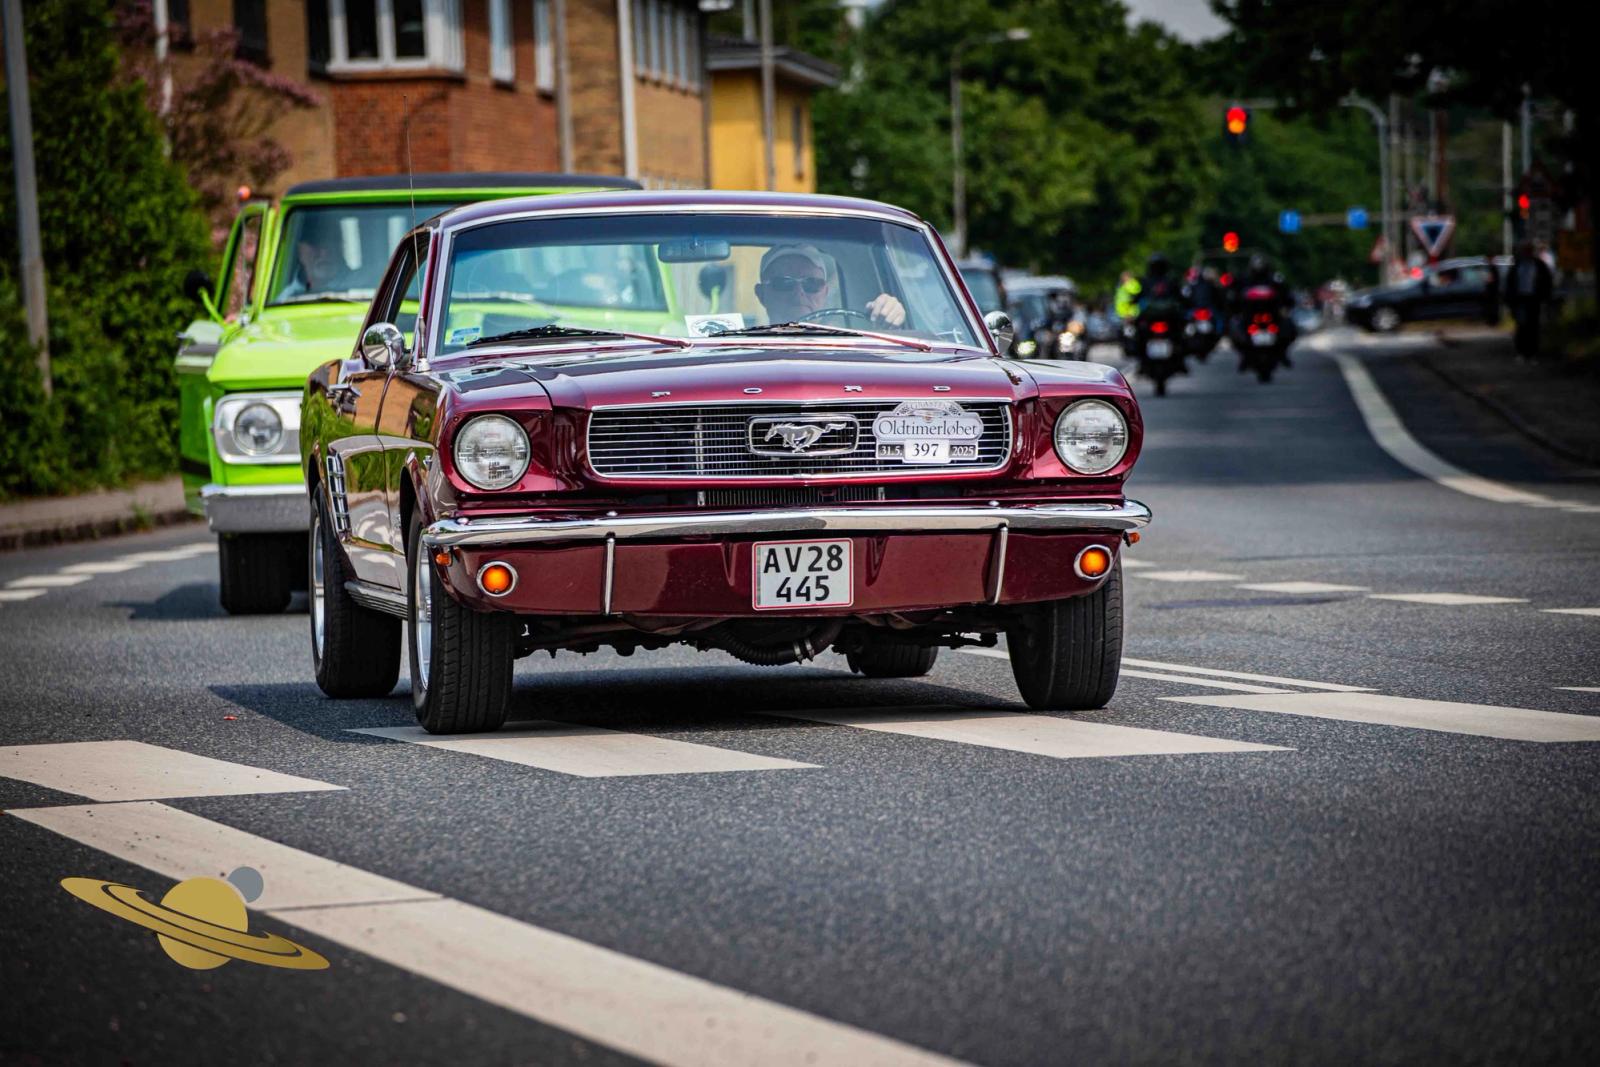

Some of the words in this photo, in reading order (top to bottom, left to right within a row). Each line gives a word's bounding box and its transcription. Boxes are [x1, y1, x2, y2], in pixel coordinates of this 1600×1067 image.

[651, 385, 951, 397] FORD
[879, 420, 976, 436] Oldtimerløbet
[912, 443, 939, 457] 397
[952, 446, 974, 456] 2025
[763, 544, 843, 573] AV28
[776, 575, 830, 602] 445
